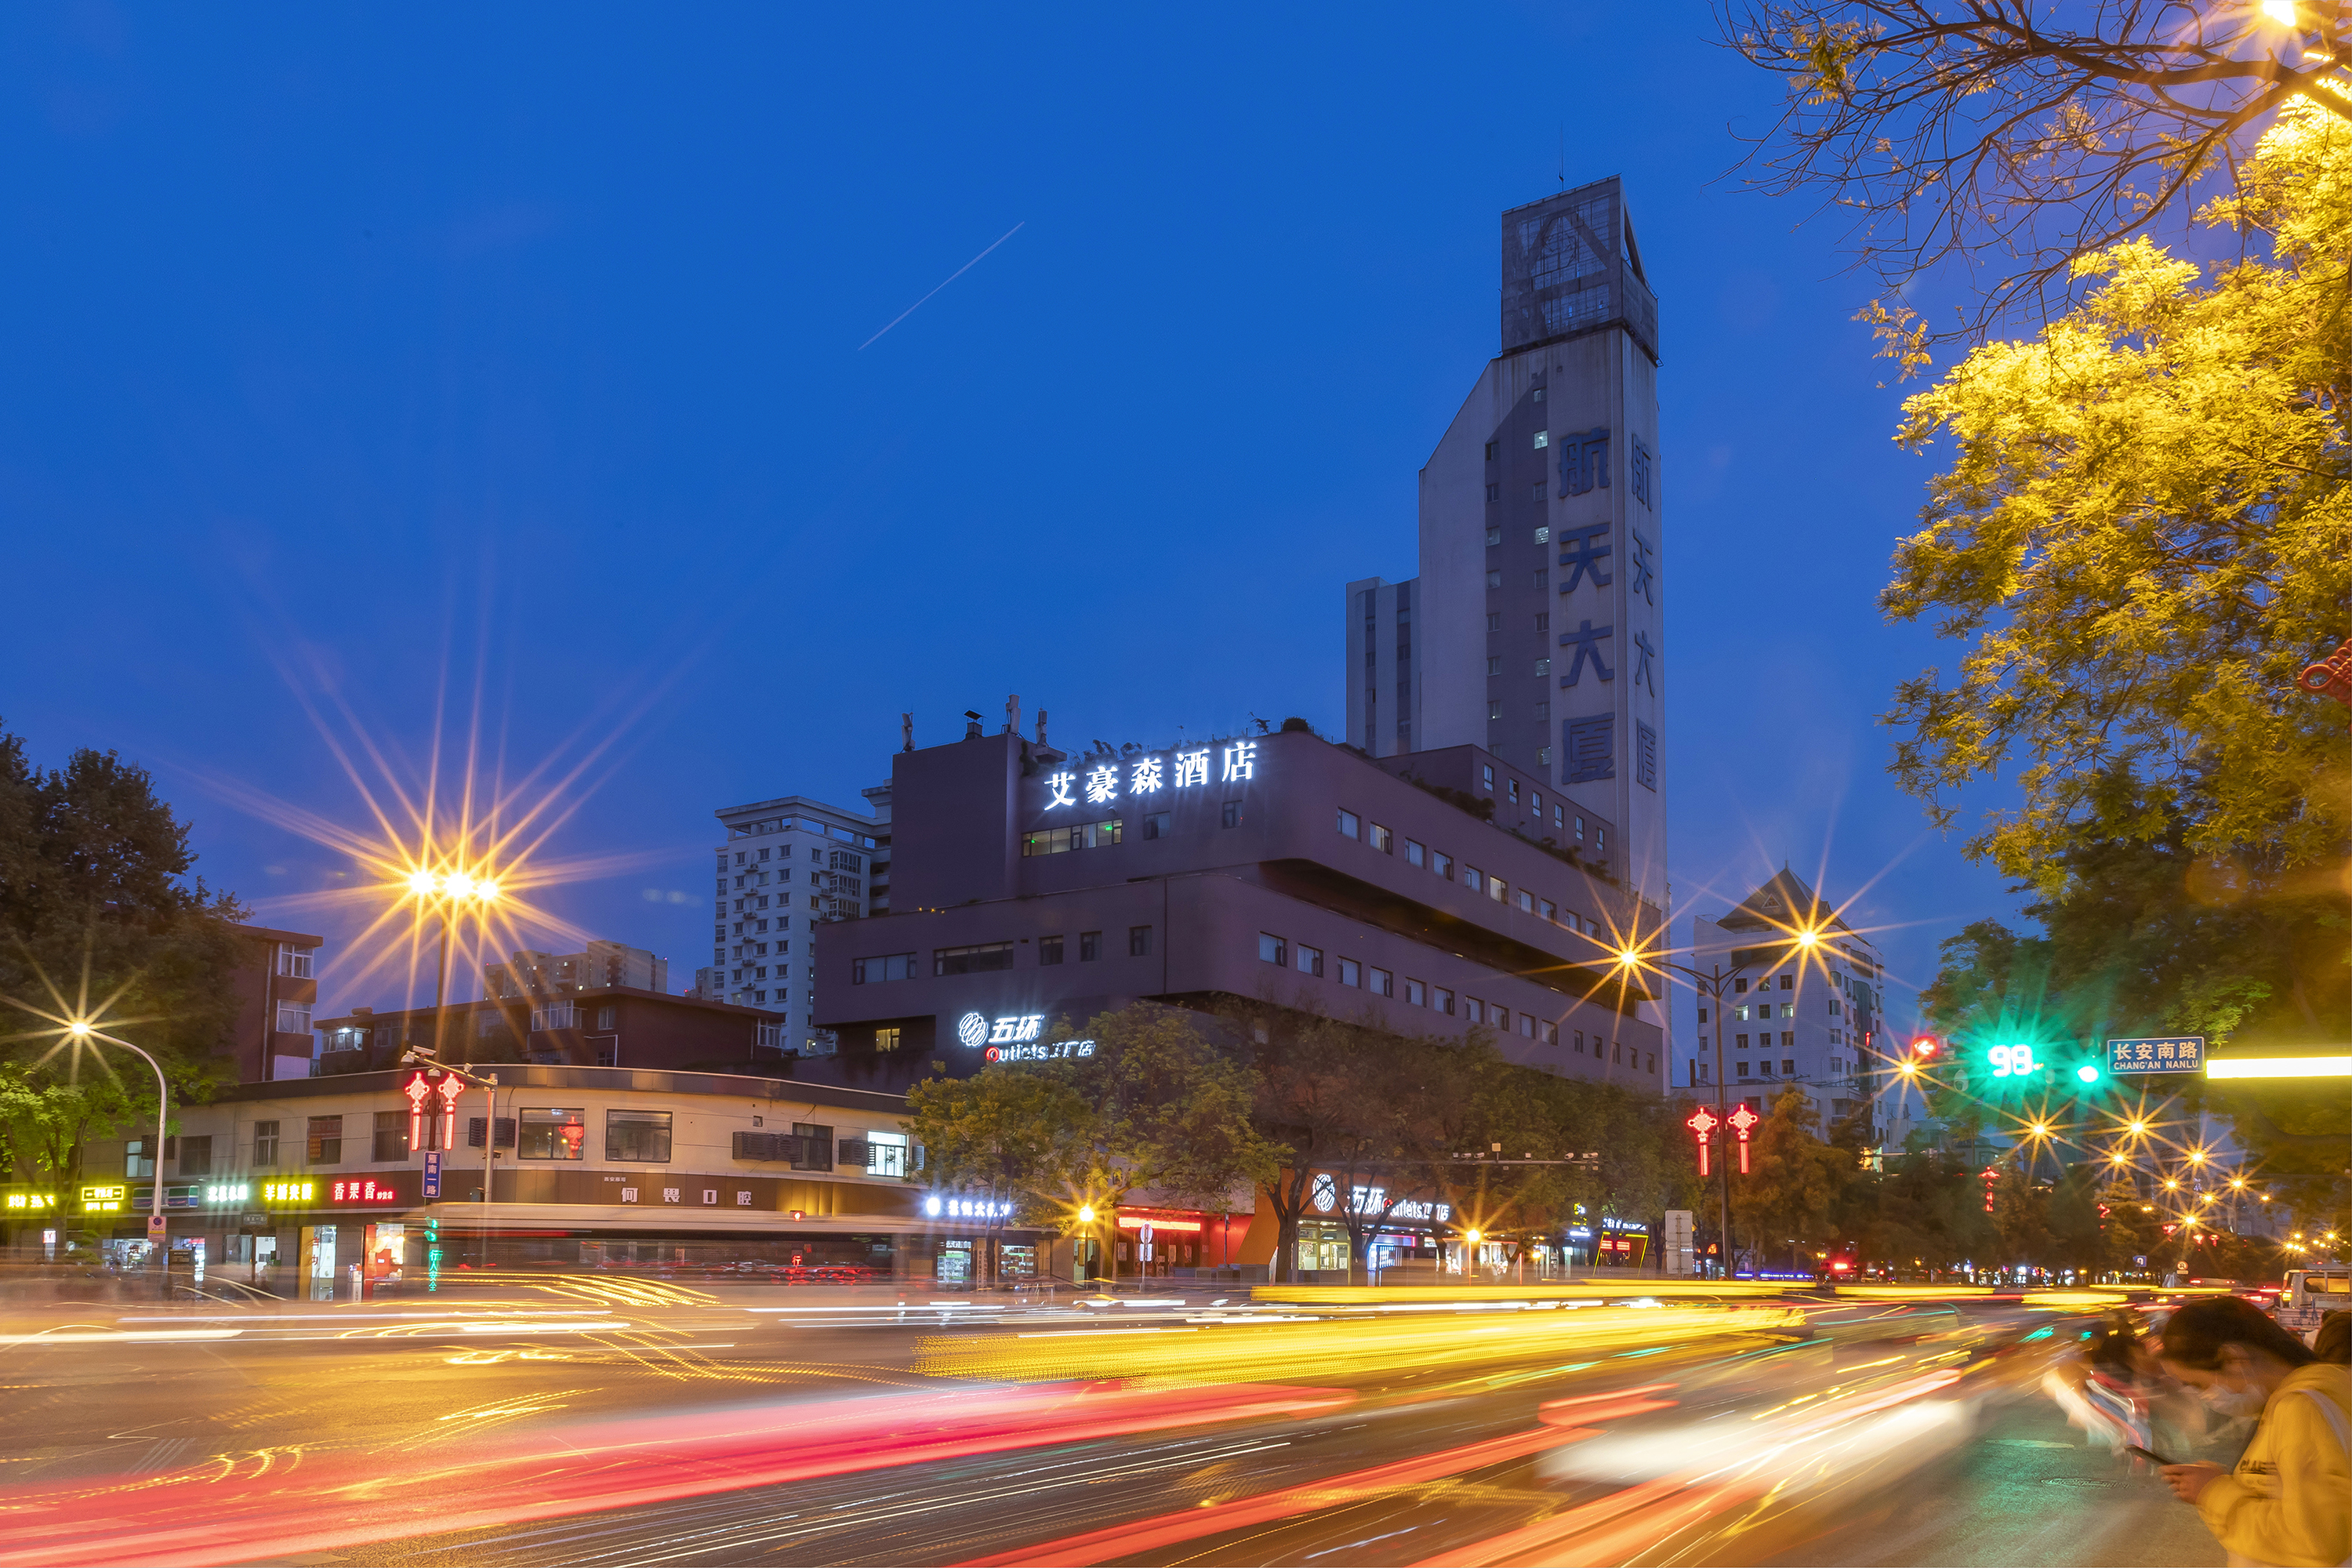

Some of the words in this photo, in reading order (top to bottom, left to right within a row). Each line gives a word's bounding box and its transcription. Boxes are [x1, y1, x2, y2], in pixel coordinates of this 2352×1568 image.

[1044, 742, 1258, 811] 艾豪森酒店
[988, 1014, 1046, 1044] 五环
[2114, 1041, 2198, 1061] 长安南路
[2114, 1061, 2161, 1070] CHANG'AN
[2165, 1060, 2198, 1069] NANLU
[622, 1187, 752, 1206] 何畏口腔
